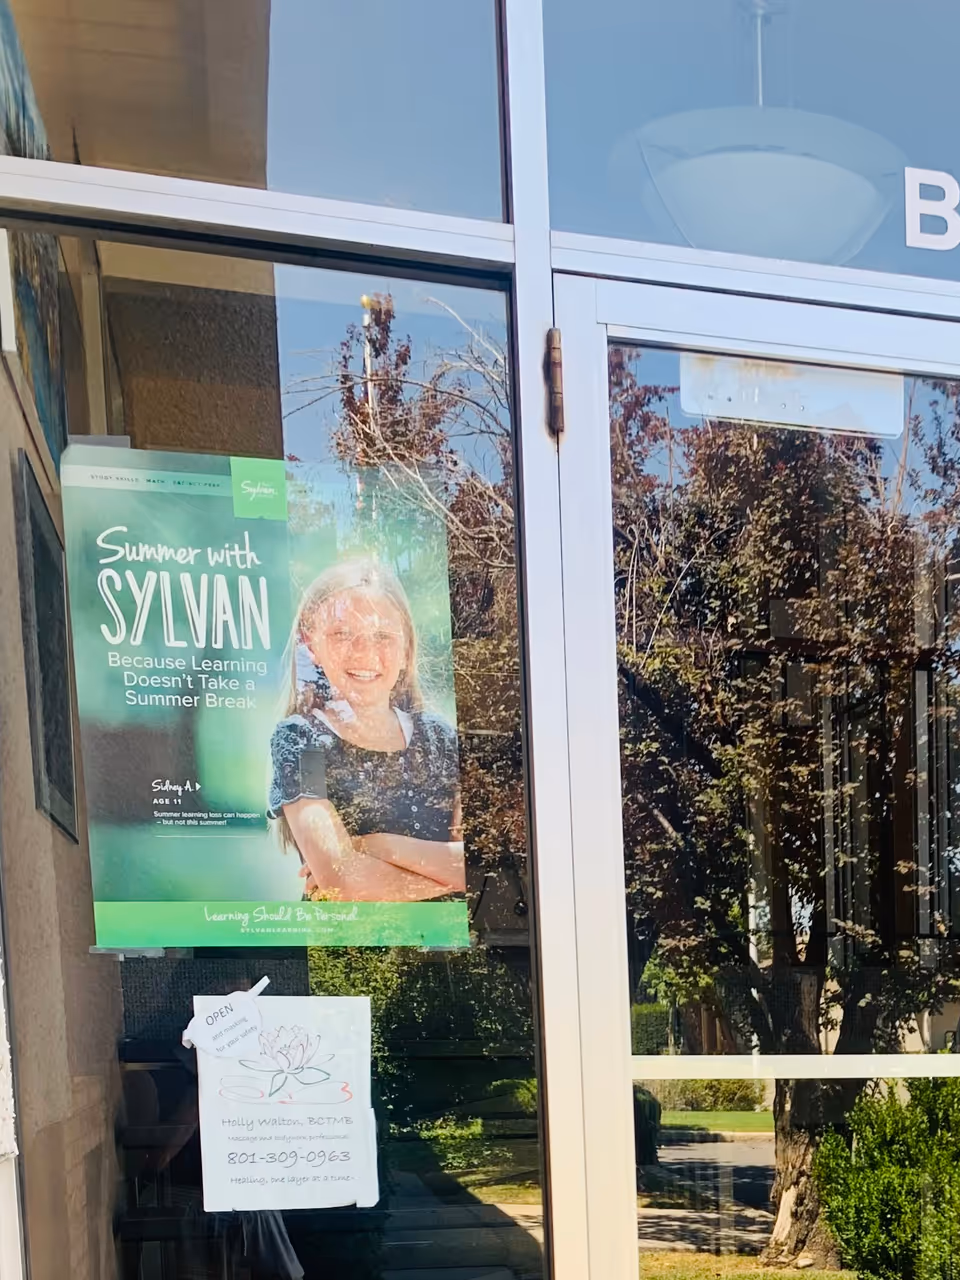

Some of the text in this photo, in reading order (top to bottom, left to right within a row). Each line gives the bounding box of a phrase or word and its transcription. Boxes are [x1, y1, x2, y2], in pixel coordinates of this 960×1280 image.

[96, 525, 261, 569] Summer with
[98, 568, 271, 650] SYLVAN
[108, 652, 267, 676] Because Learning
[123, 671, 255, 690] Doesn't Take a
[125, 690, 257, 709] Summer Break
[151, 779, 183, 796] Sidney
[182, 811, 208, 819] learning
[204, 905, 249, 926] Learning
[205, 1002, 234, 1026] OPEN
[221, 1116, 254, 1131] Holly
[227, 1150, 351, 1169] 801-309-0963
